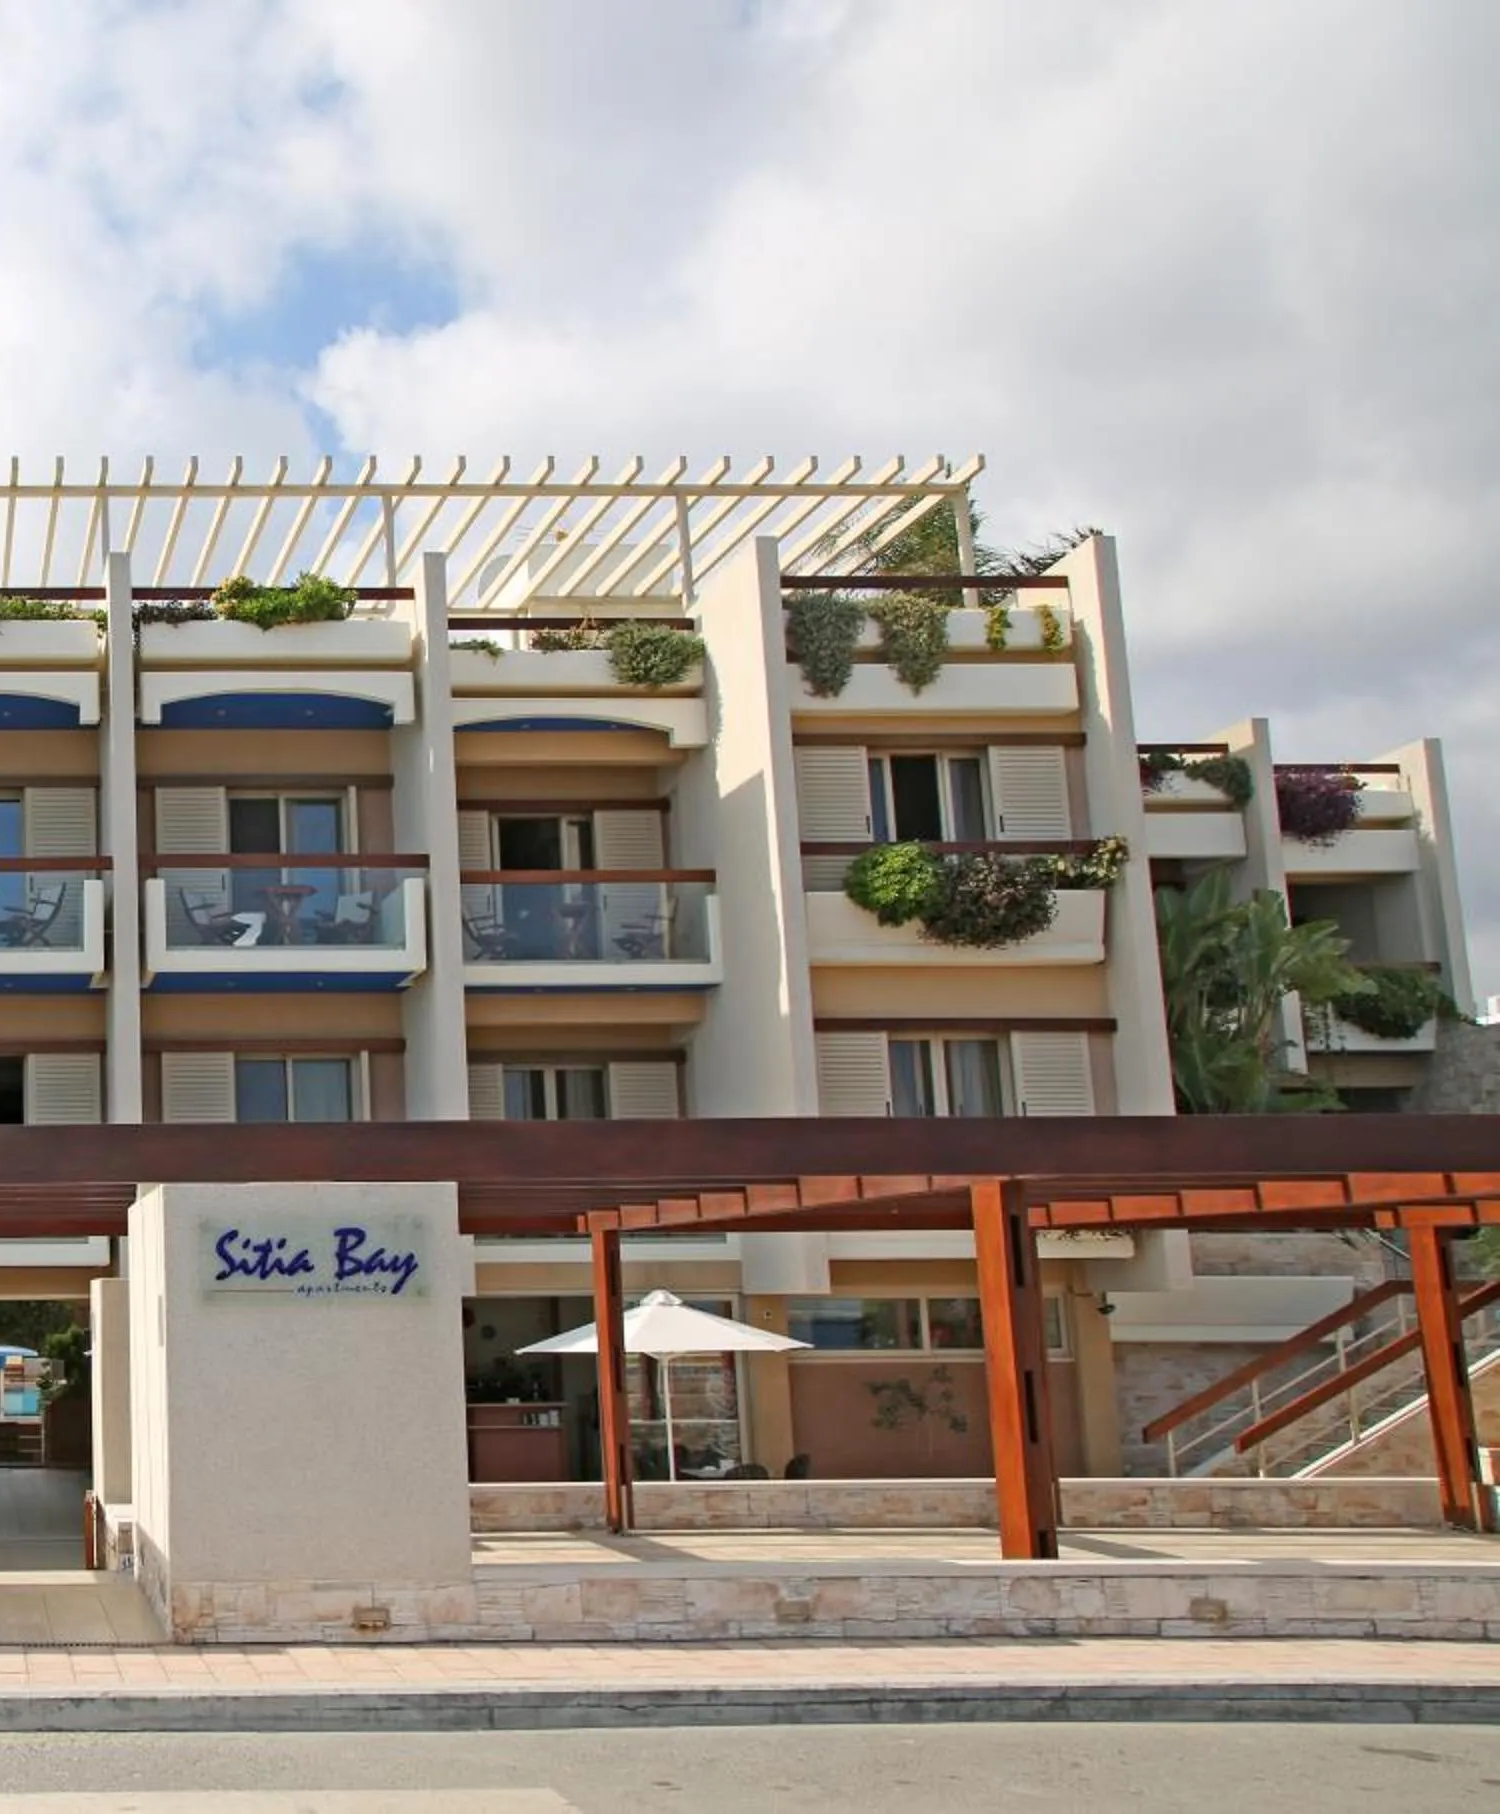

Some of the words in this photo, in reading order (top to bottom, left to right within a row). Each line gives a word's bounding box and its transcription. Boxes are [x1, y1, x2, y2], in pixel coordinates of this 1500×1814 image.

[215, 1229, 315, 1280] Sitia
[333, 1227, 419, 1295] Bay
[297, 1281, 387, 1297] apartments
